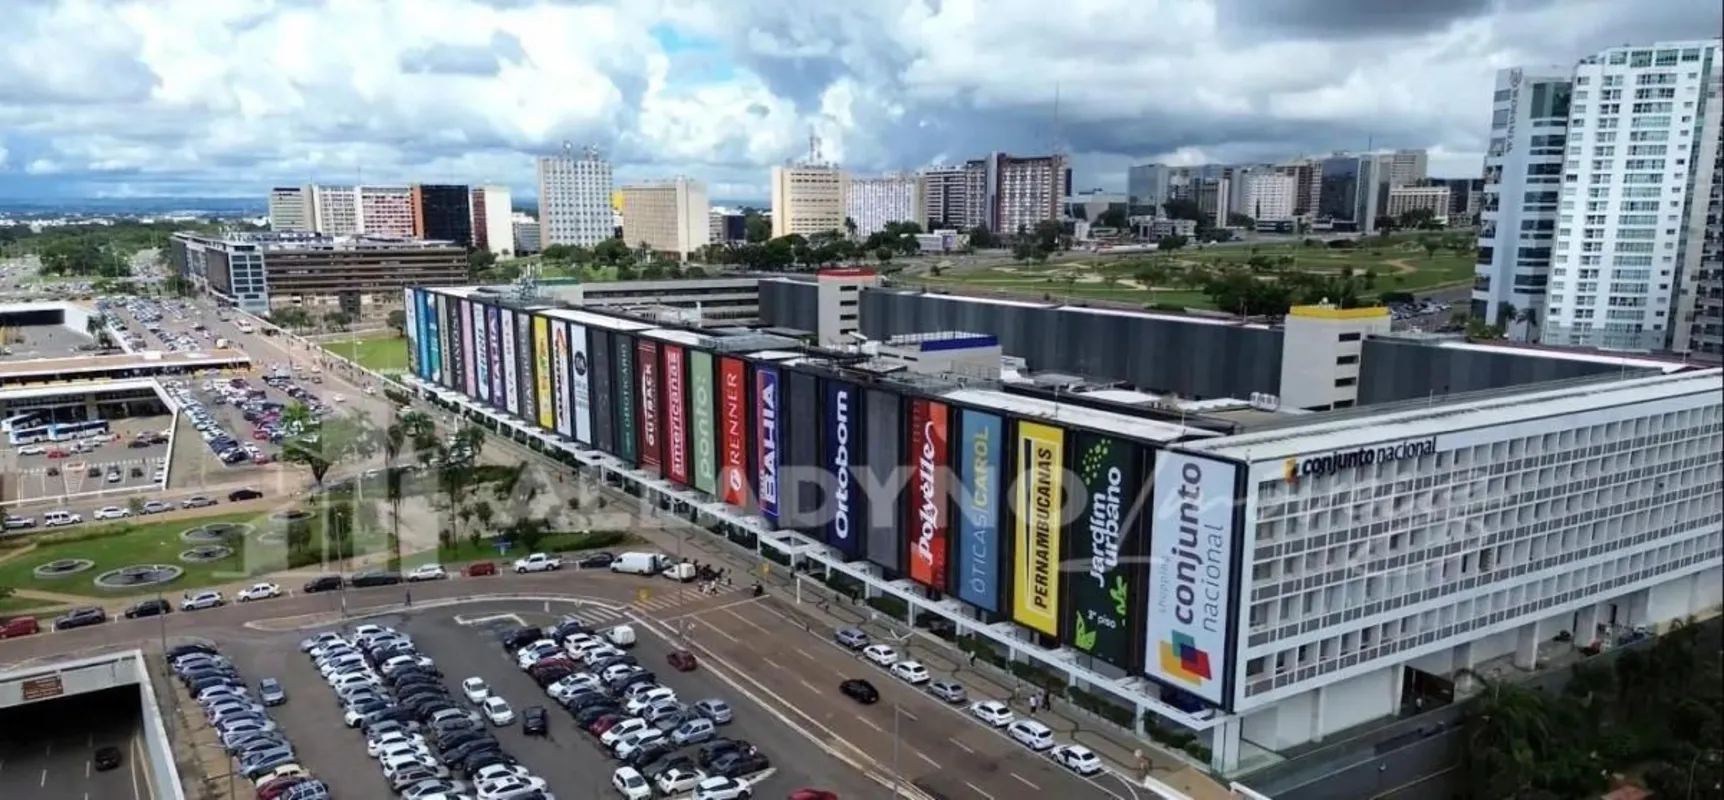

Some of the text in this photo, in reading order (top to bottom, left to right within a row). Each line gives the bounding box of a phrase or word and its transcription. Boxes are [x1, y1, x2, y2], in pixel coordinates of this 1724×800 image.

[643, 363, 655, 446] OUTBACK
[668, 352, 685, 475] americanas
[728, 372, 742, 464] RENNER
[761, 383, 777, 504] BAHIA
[1302, 436, 1437, 476] conjunto nacional
[835, 390, 848, 539] Ortobom
[974, 425, 989, 507] CAROL
[1034, 447, 1052, 609] PERNAMBUCANAS
[1090, 492, 1105, 588] Jardim
[1102, 466, 1121, 573] urbano
[1172, 462, 1204, 625] conjunto
[1097, 613, 1117, 629] piso
[1201, 523, 1224, 633] nacional
